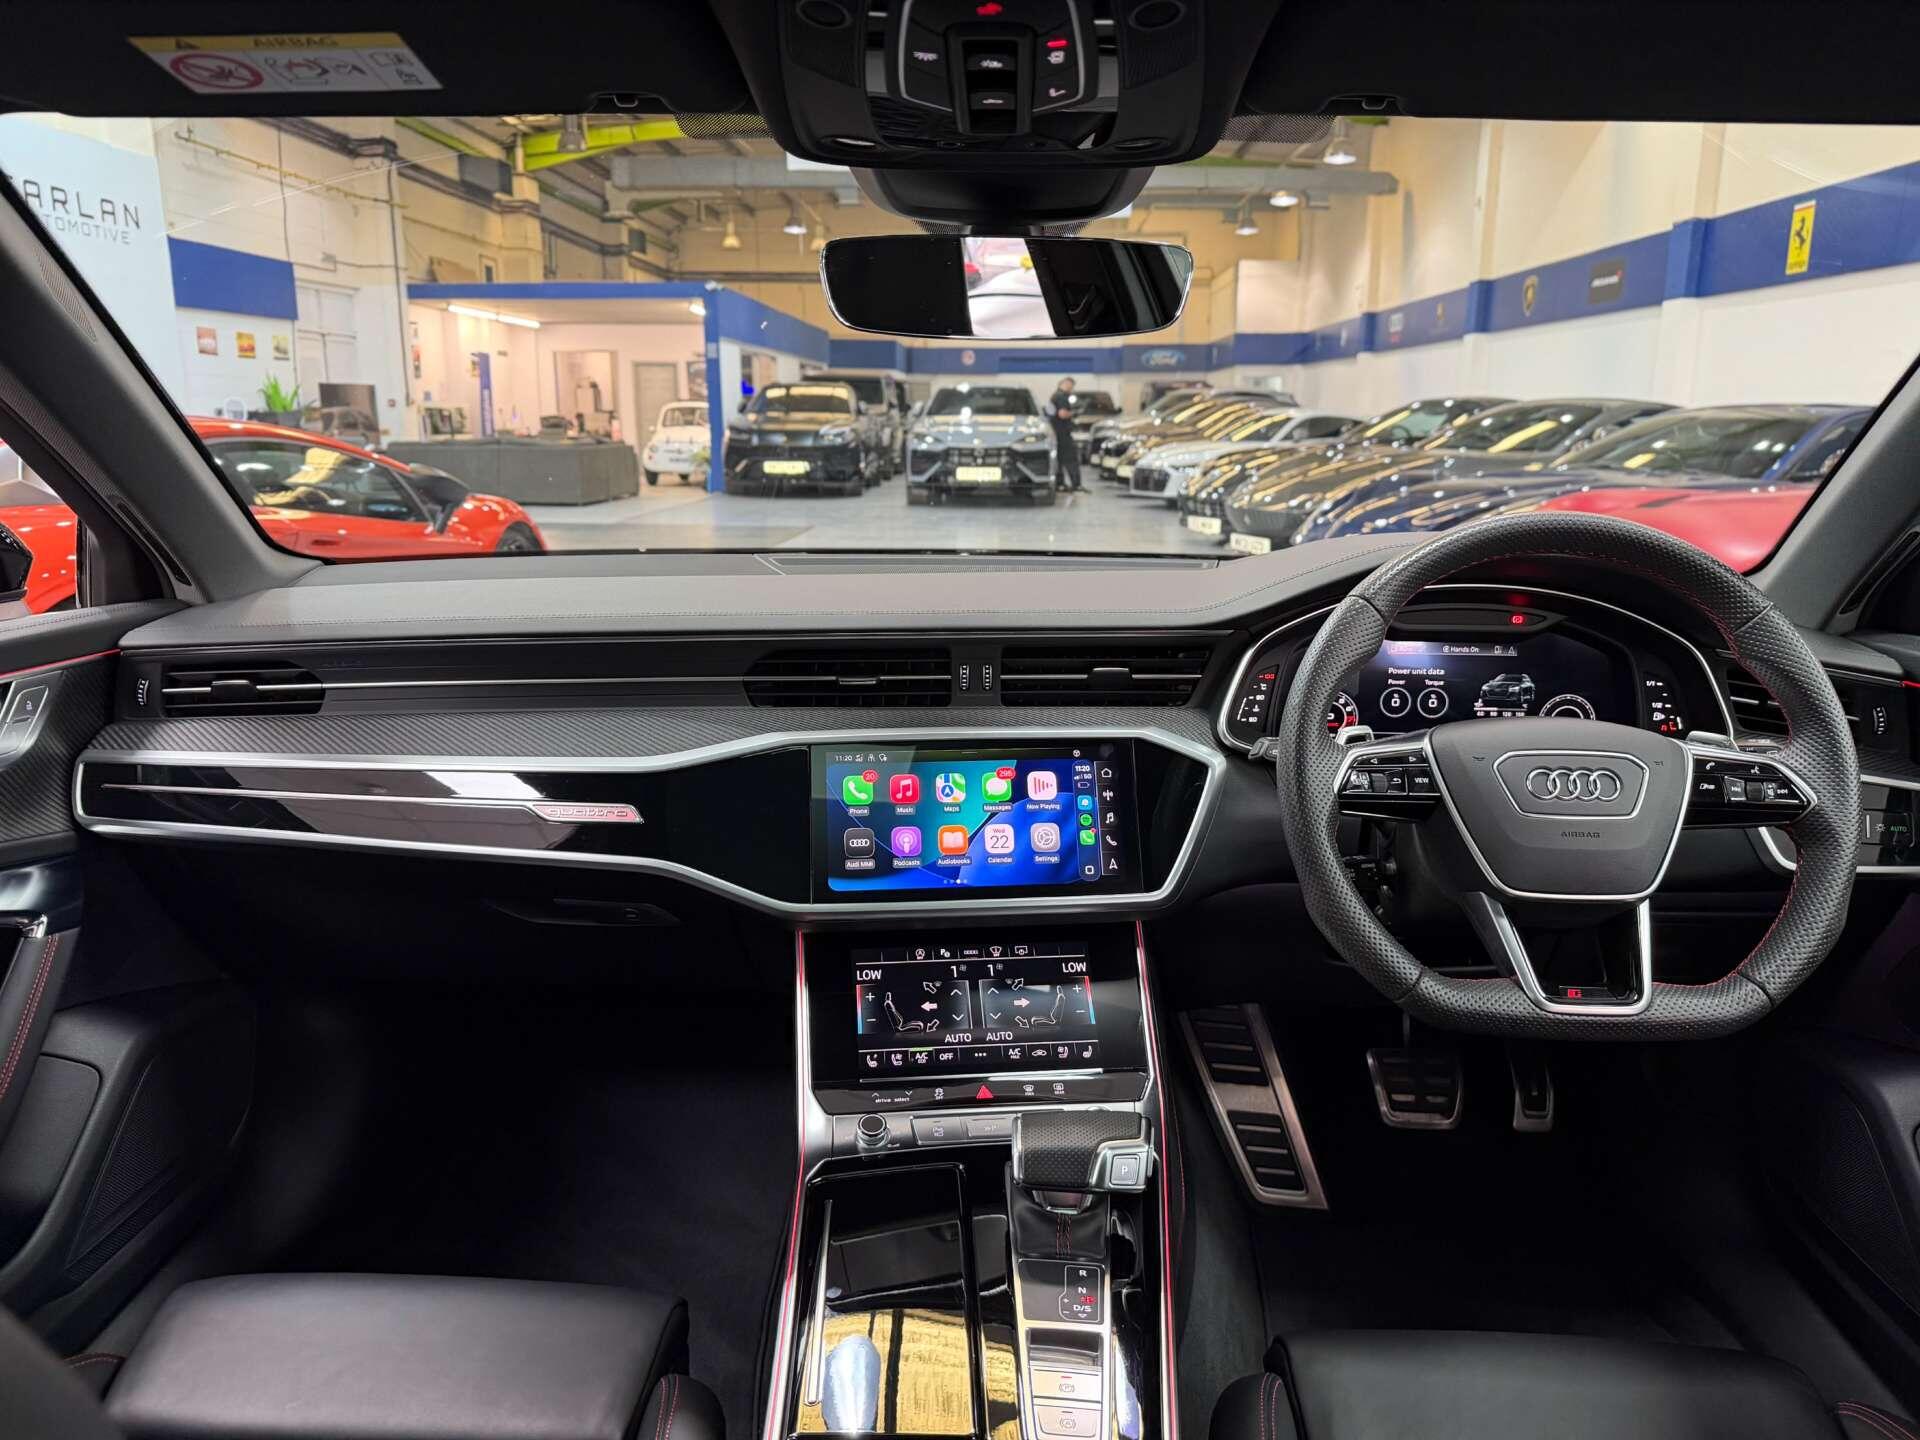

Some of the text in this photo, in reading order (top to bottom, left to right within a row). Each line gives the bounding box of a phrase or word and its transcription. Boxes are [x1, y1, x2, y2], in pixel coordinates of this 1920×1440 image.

[9, 175, 141, 230] ARLAN
[1388, 667, 1411, 675] Power
[1428, 668, 1445, 676] data
[1425, 679, 1445, 687] Torque
[849, 807, 868, 815] Phone
[984, 804, 1012, 812] Messages
[1040, 803, 1060, 811] Playing
[549, 807, 628, 819] quattro
[1890, 825, 1908, 833] AUTO
[1560, 831, 1600, 839] AIRBAG
[990, 835, 1009, 849] 22
[894, 859, 920, 867] Podcasts
[1062, 962, 1086, 973] LOW
[857, 969, 882, 981] LOW
[944, 1031, 1013, 1043] AUTO AUTO
[915, 1052, 929, 1060] A/C
[939, 1052, 953, 1060] OFF
[1121, 1164, 1128, 1175] P
[1079, 1269, 1087, 1277] R
[1078, 1286, 1087, 1294] N
[1073, 1304, 1092, 1312] D/S
